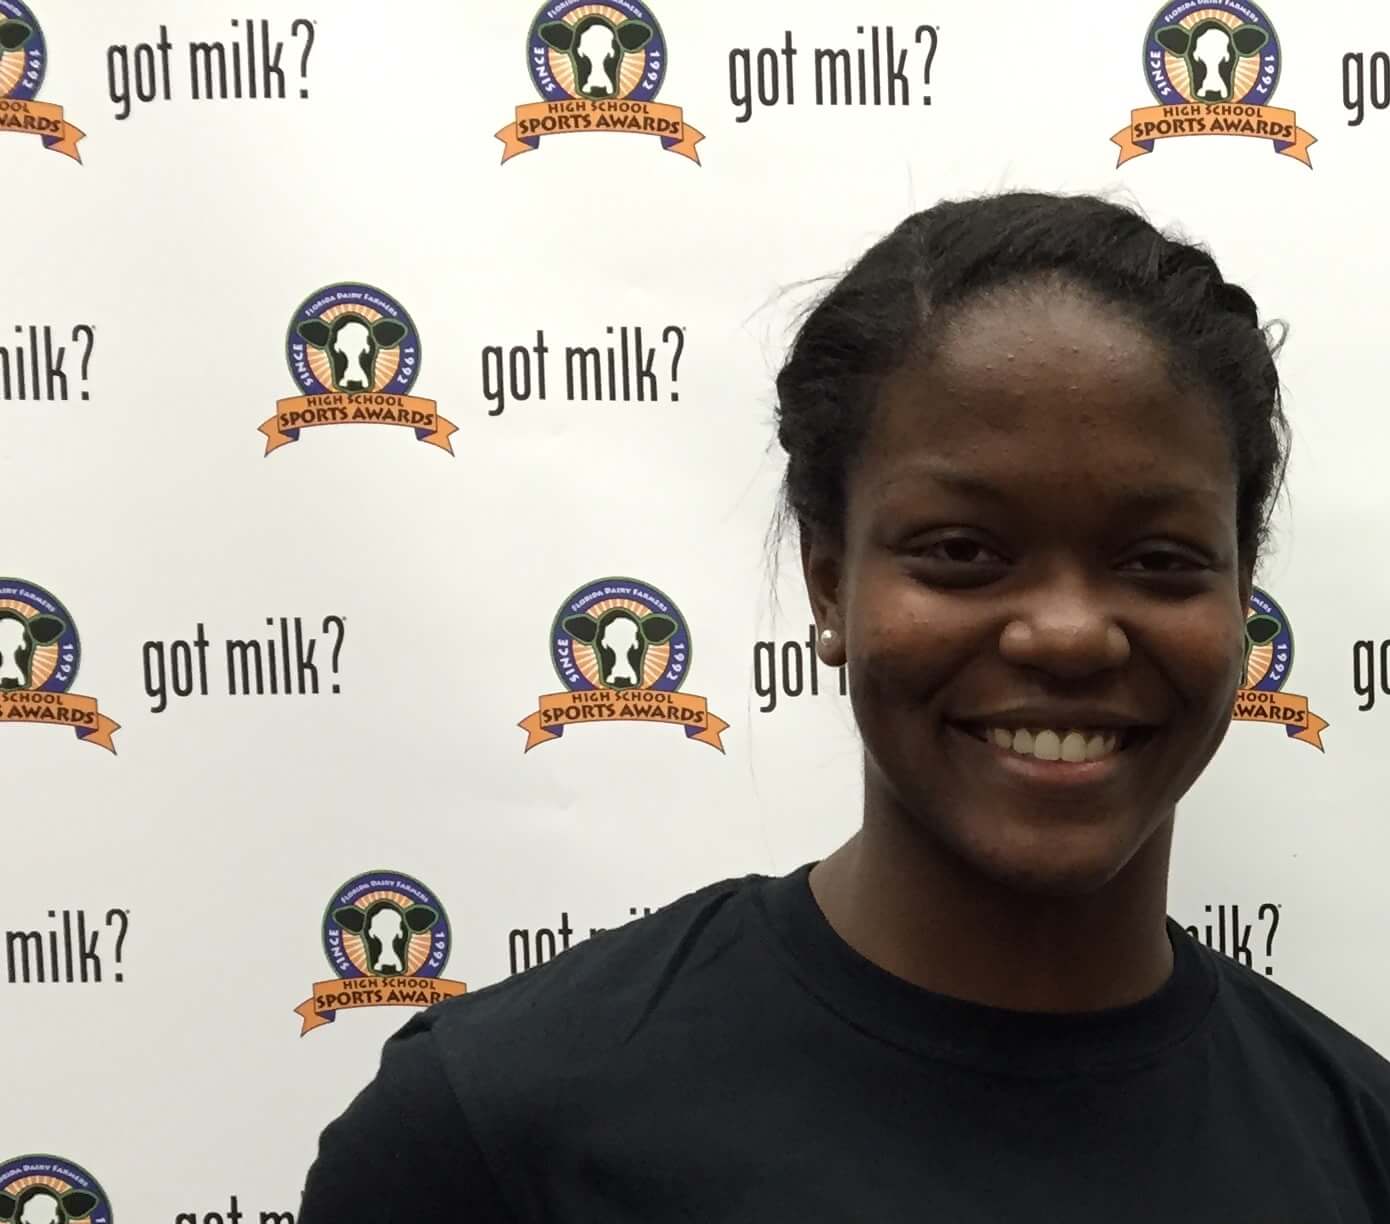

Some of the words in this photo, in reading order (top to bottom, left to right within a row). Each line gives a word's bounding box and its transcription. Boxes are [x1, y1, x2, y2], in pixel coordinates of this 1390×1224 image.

[107, 25, 172, 120] got
[190, 19, 314, 99] milk?
[729, 31, 797, 123] got
[815, 25, 937, 105] milk?
[549, 102, 586, 113] HIGH
[591, 102, 649, 114] SCHOOL
[1164, 106, 1201, 117] HIGH
[1206, 106, 1262, 118] SCHOOL
[519, 114, 591, 134] SPORTS
[596, 114, 680, 134] AWARDS
[1134, 118, 1206, 138] SPORTS
[1210, 118, 1293, 137] AWARDS
[482, 330, 548, 416] got
[566, 326, 684, 401] milk?
[307, 396, 344, 407] HIGH
[348, 395, 403, 406] SCHOOL
[279, 407, 348, 427] SPORTS
[353, 407, 433, 425] AWARDS
[143, 623, 209, 713] got
[226, 616, 344, 695] milk?
[558, 639, 580, 682] SINCE
[666, 644, 685, 680] 1992
[754, 624, 818, 712] got
[1, 693, 63, 705] SCHOOL
[572, 692, 610, 703] HIGH
[615, 692, 673, 704] SCHOOL
[8, 705, 95, 724] AWARDS
[542, 704, 615, 723] SPORTS
[620, 704, 704, 723] AWARDS
[6, 909, 128, 983] milk?
[1184, 903, 1280, 975] ilk?
[343, 979, 378, 990] HIGH
[382, 978, 435, 989] SCHOOL
[316, 990, 383, 1009] SPORTS
[387, 990, 449, 1006] AWAR
